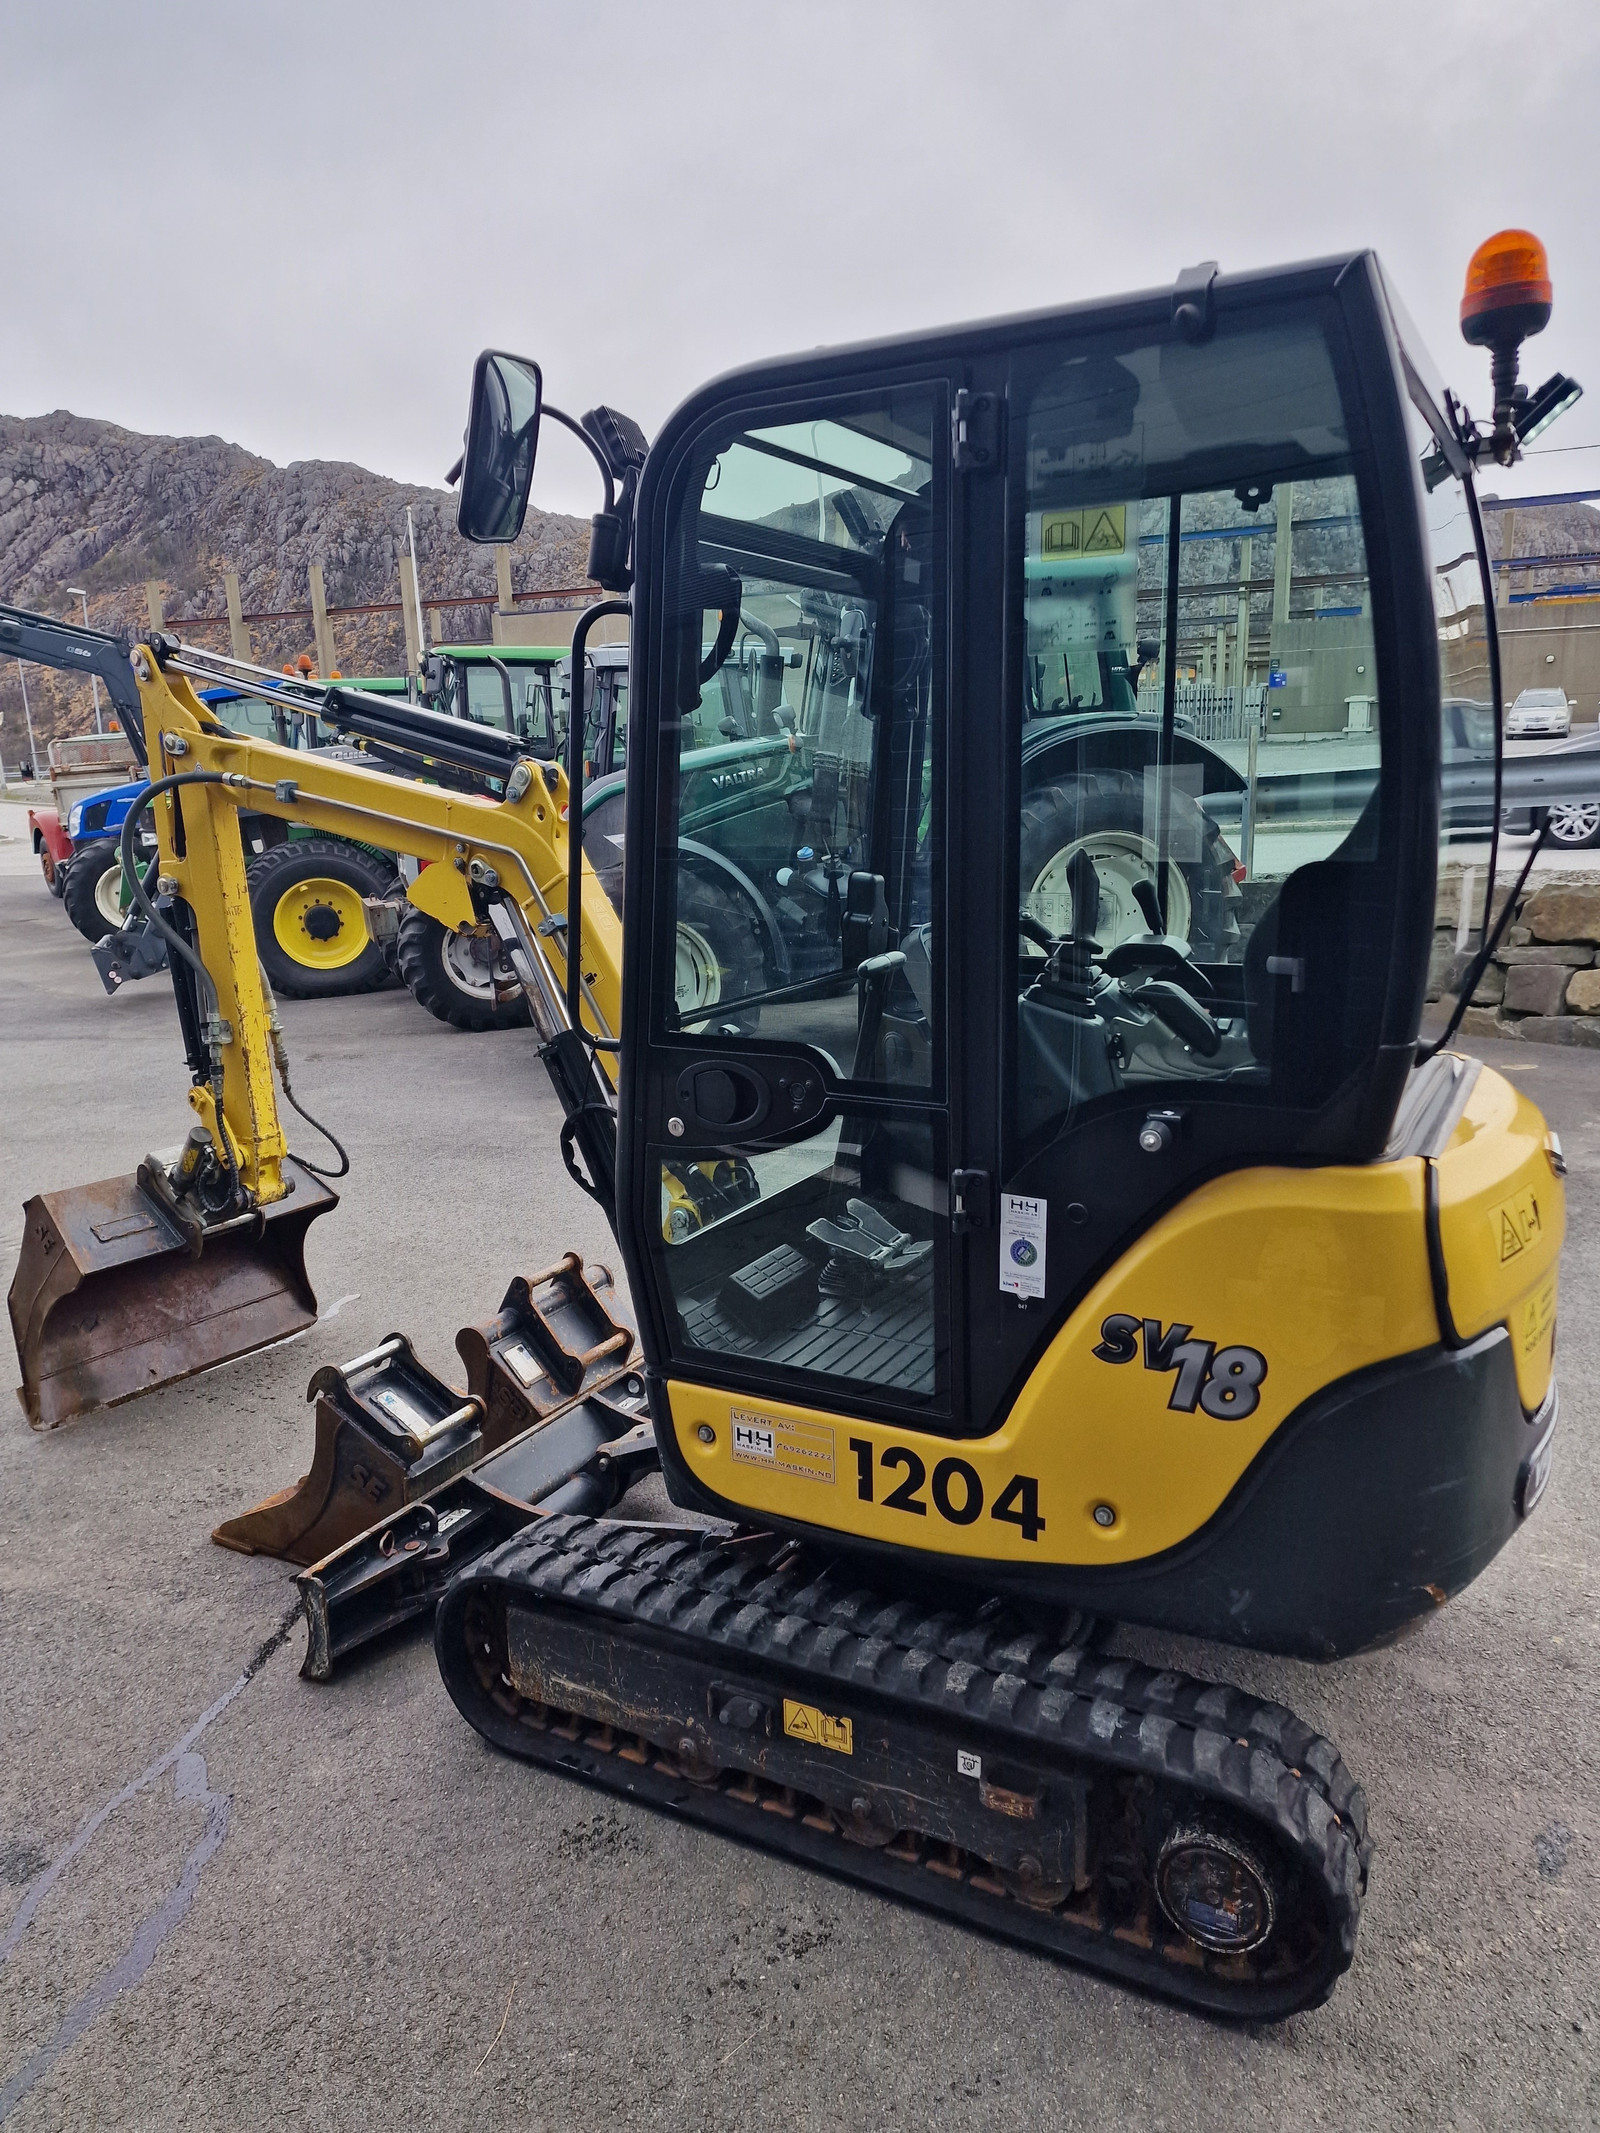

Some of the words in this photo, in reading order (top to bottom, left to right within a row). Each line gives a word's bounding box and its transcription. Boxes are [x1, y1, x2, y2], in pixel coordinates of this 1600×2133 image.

[331, 750, 374, 761] QUIC
[711, 766, 766, 789] VALTRA
[1091, 1313, 1268, 1421] SV18
[733, 1411, 773, 1426] LEVERT
[736, 1442, 762, 1452] MASKIN
[783, 1444, 832, 1461] 69262222
[849, 1437, 1046, 1542] 1204
